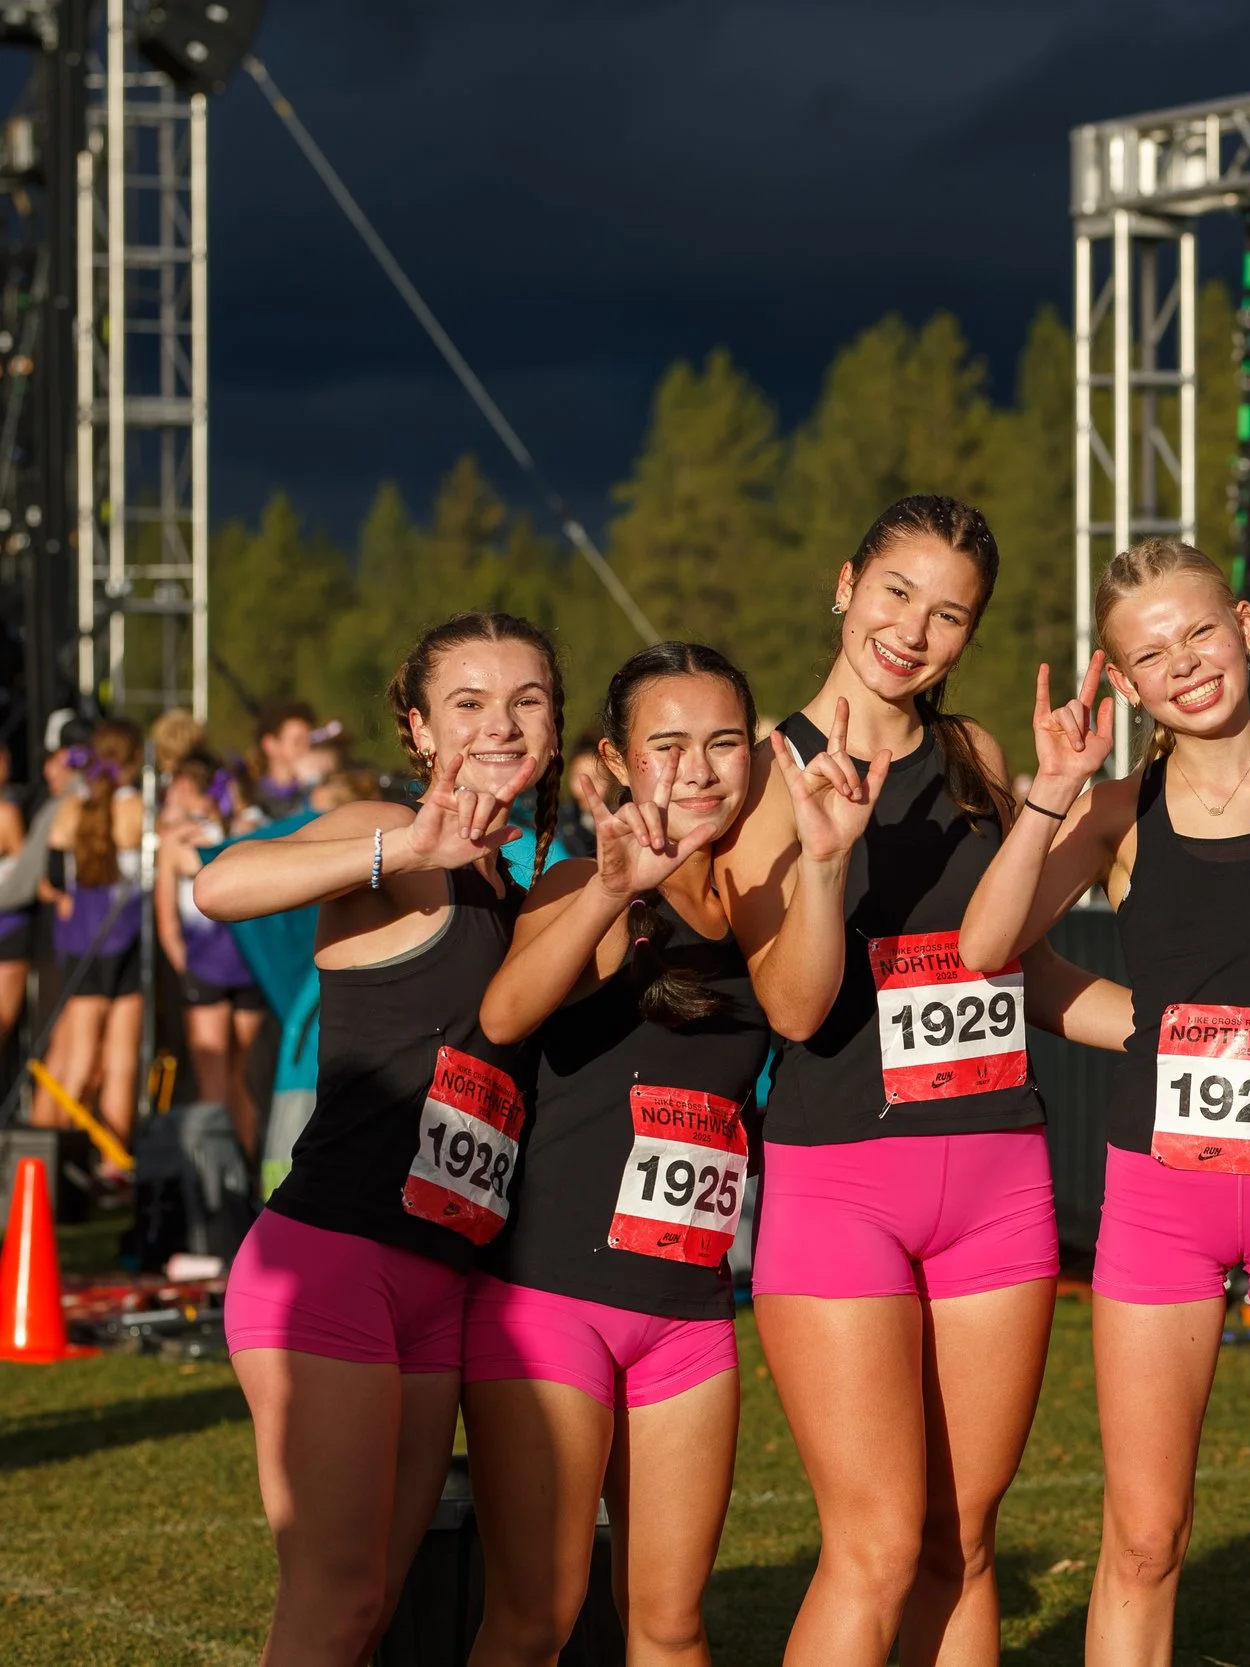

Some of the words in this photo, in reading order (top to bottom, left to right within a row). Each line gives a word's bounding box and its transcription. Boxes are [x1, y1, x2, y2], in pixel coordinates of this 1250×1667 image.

[914, 944, 942, 954] CROSS
[880, 952, 966, 976] NORTHW
[936, 971, 958, 980] 2025
[891, 991, 1016, 1050] 1929
[1187, 1016, 1209, 1025] NIKE
[1212, 1016, 1242, 1026] CROSS
[936, 1071, 954, 1082] RUN
[655, 1098, 673, 1108] NIKE
[676, 1101, 703, 1112] CROSS
[641, 1106, 738, 1141] NORTHWEST
[692, 1132, 712, 1143] 2025
[1203, 1147, 1222, 1155] RUN
[427, 1122, 510, 1199] 1928
[637, 1155, 739, 1217] 1925
[663, 1232, 681, 1242] RUN
